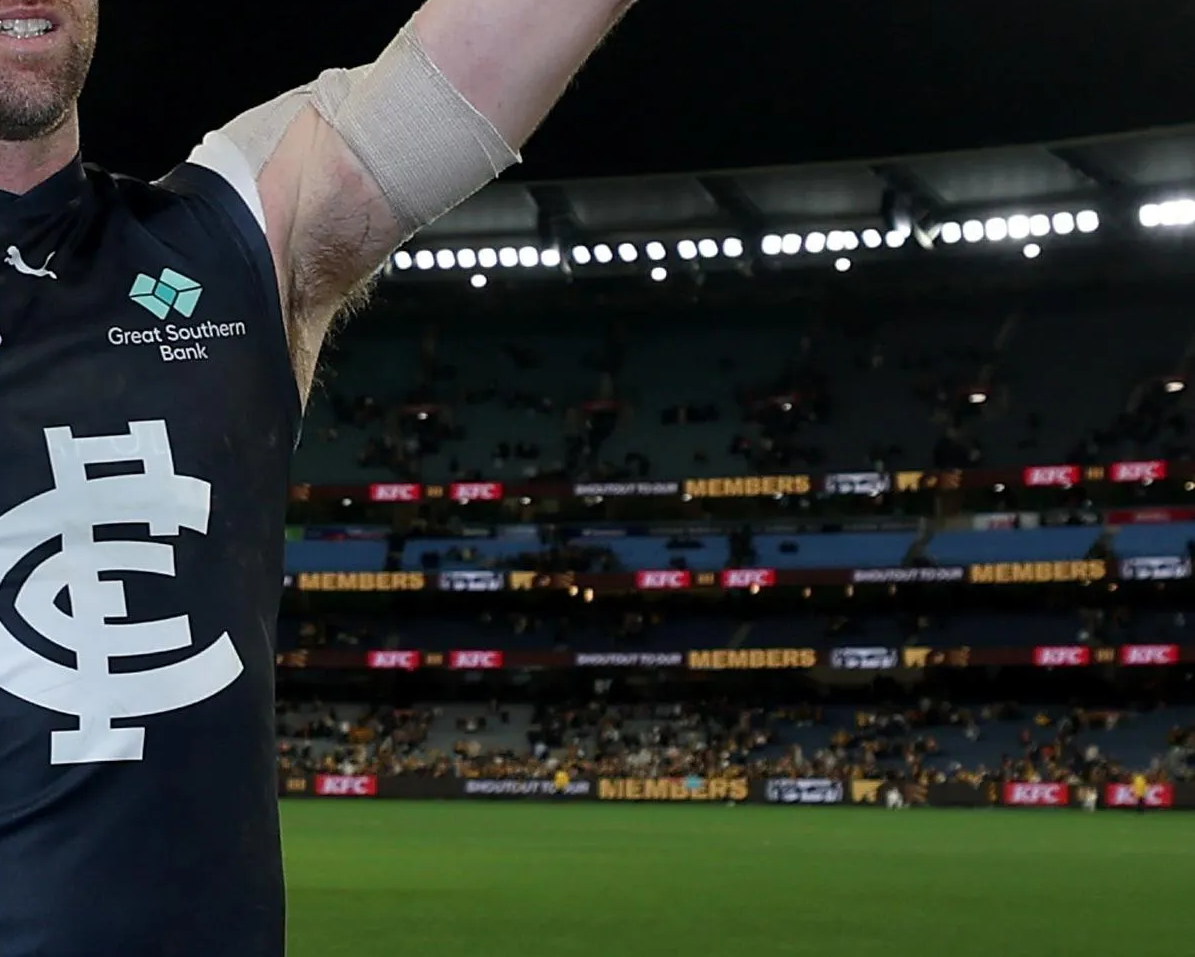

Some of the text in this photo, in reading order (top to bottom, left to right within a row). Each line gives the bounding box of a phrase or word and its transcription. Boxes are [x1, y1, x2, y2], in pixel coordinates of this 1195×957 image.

[107, 320, 246, 345] Great Southern
[161, 343, 208, 361] Bank
[1031, 466, 1070, 484] KFC
[1117, 462, 1156, 480] KFC
[375, 484, 415, 501] KFC
[457, 483, 497, 500] KFC
[686, 476, 809, 496] MEMBERS
[643, 571, 683, 587] KFC
[727, 570, 767, 587] KFC
[970, 560, 1105, 583] MEMBERS
[299, 571, 424, 591] MEMBERS
[373, 651, 414, 667] KFC
[457, 651, 497, 667] KFC
[690, 649, 817, 668] MEMBERS
[1042, 647, 1080, 664] KFC
[1130, 645, 1170, 663] KFC
[324, 776, 368, 795] KFC
[1013, 783, 1059, 803] KFC
[1113, 785, 1162, 805] KC
